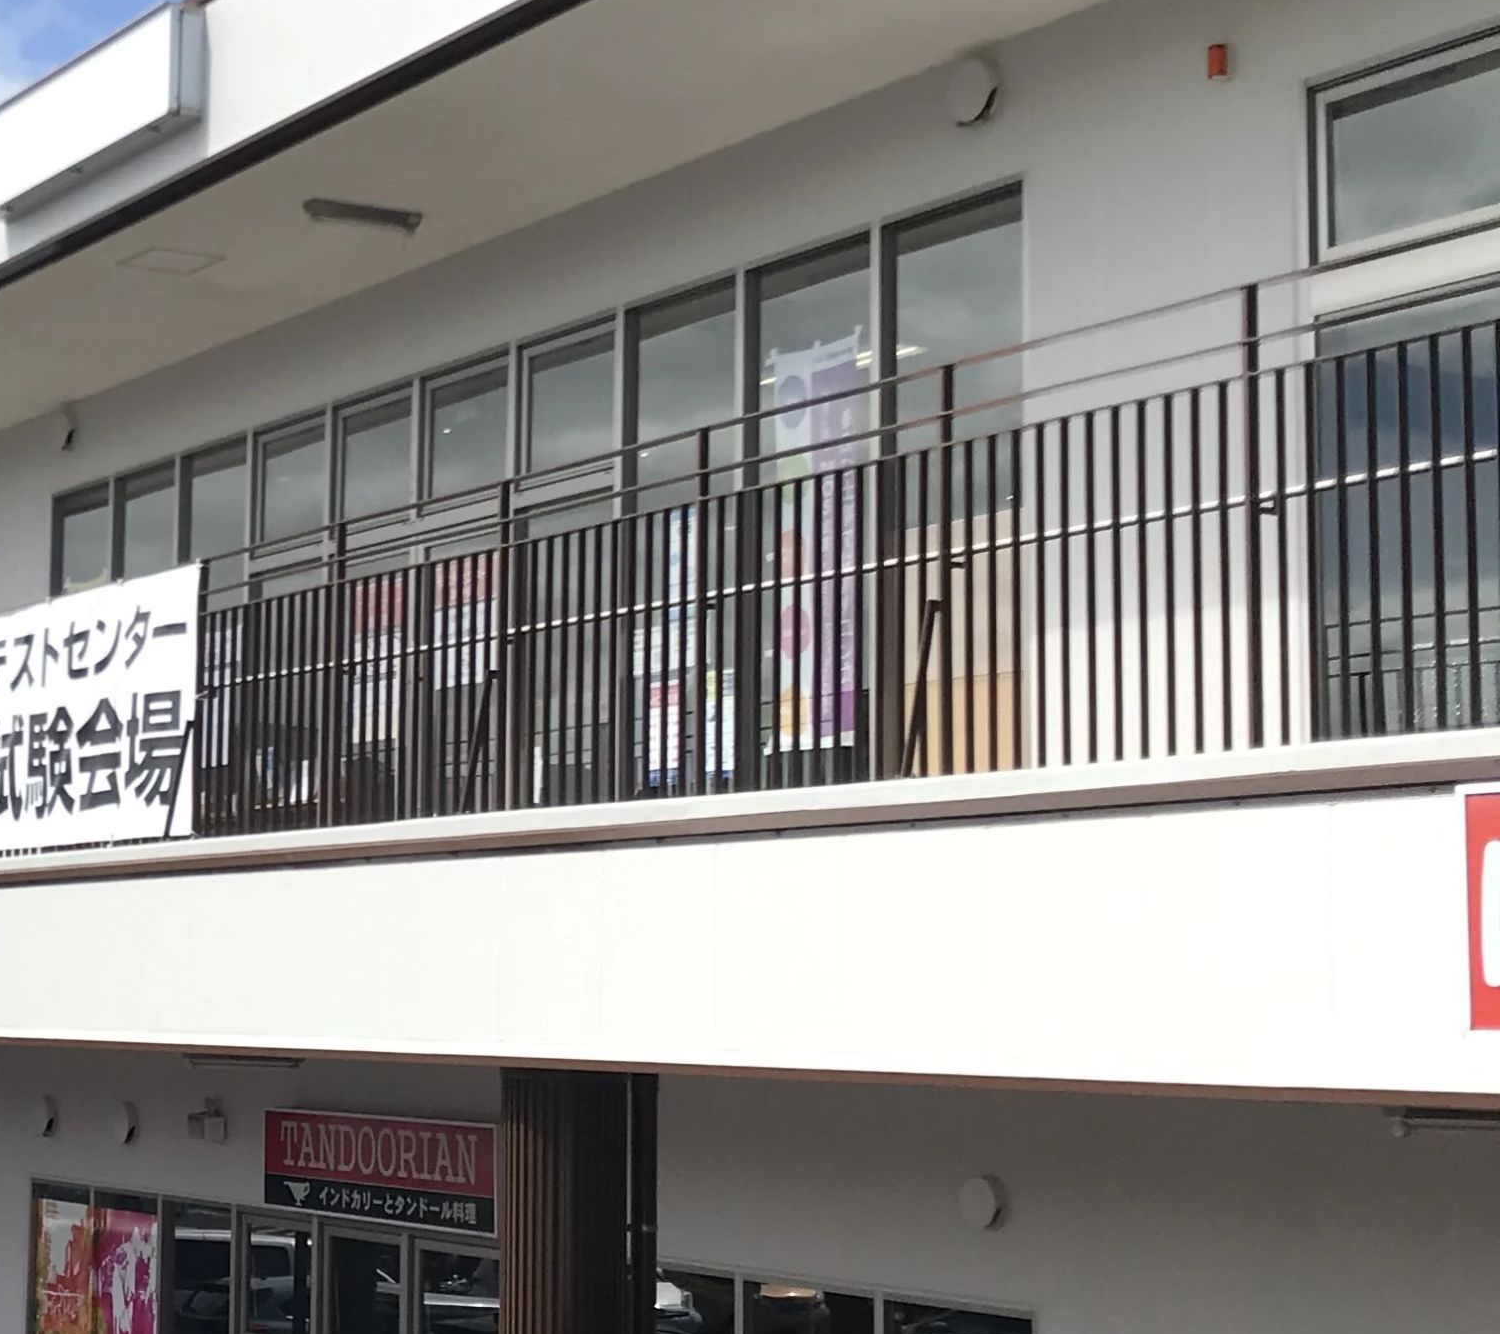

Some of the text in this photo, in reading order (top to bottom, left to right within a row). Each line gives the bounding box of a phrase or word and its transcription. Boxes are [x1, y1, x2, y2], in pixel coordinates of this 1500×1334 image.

[280, 1120, 478, 1185] TANDOORIAN
[319, 1186, 477, 1225] インドカリーとタンドール料理
